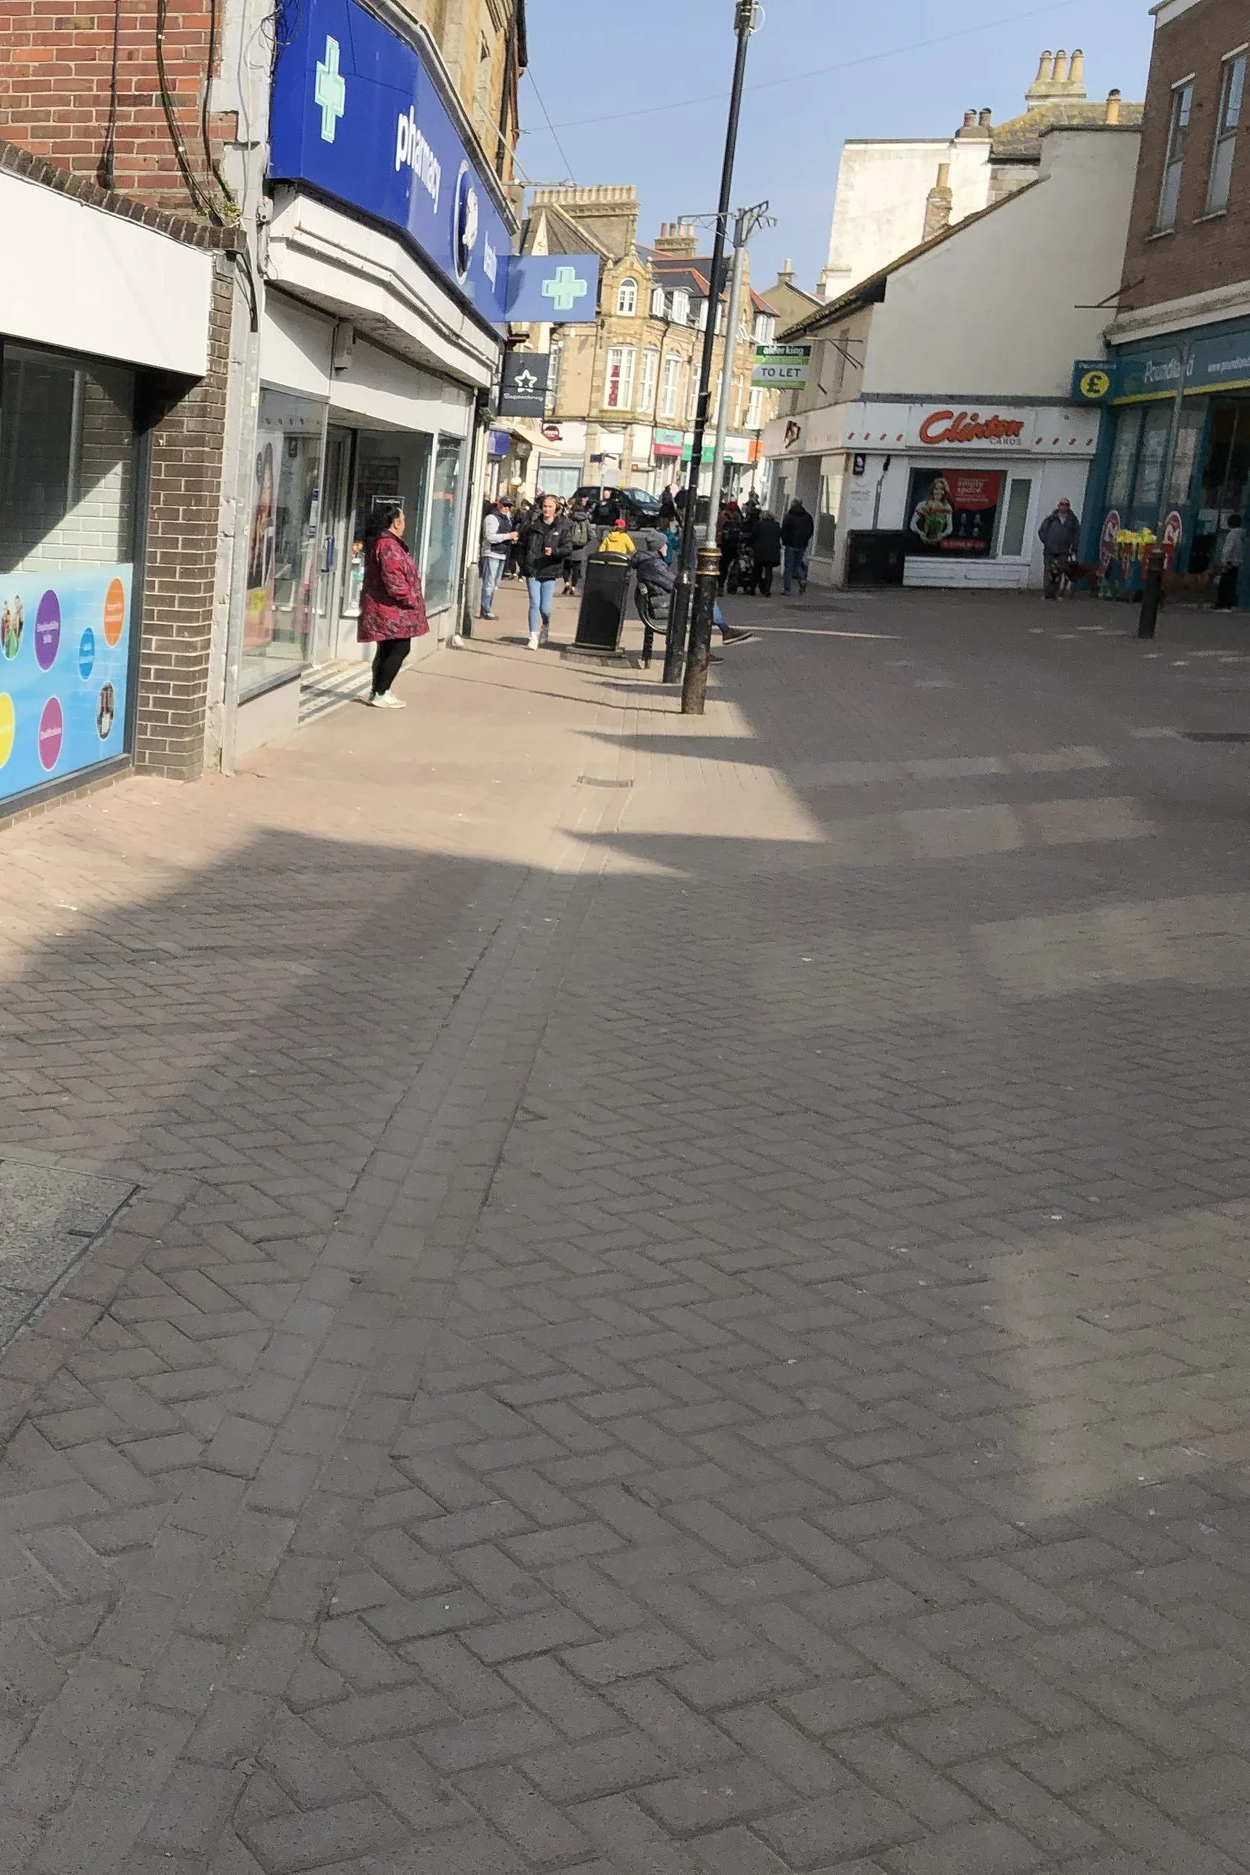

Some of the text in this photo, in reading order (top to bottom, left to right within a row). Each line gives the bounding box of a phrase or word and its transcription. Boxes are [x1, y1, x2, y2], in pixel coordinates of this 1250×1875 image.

[395, 105, 441, 214] pharmacy
[763, 346, 804, 356] alder king
[761, 368, 801, 377] TO LET
[1087, 375, 1102, 393] £
[919, 410, 1025, 444] Clinton
[990, 438, 1022, 446] CARDS
